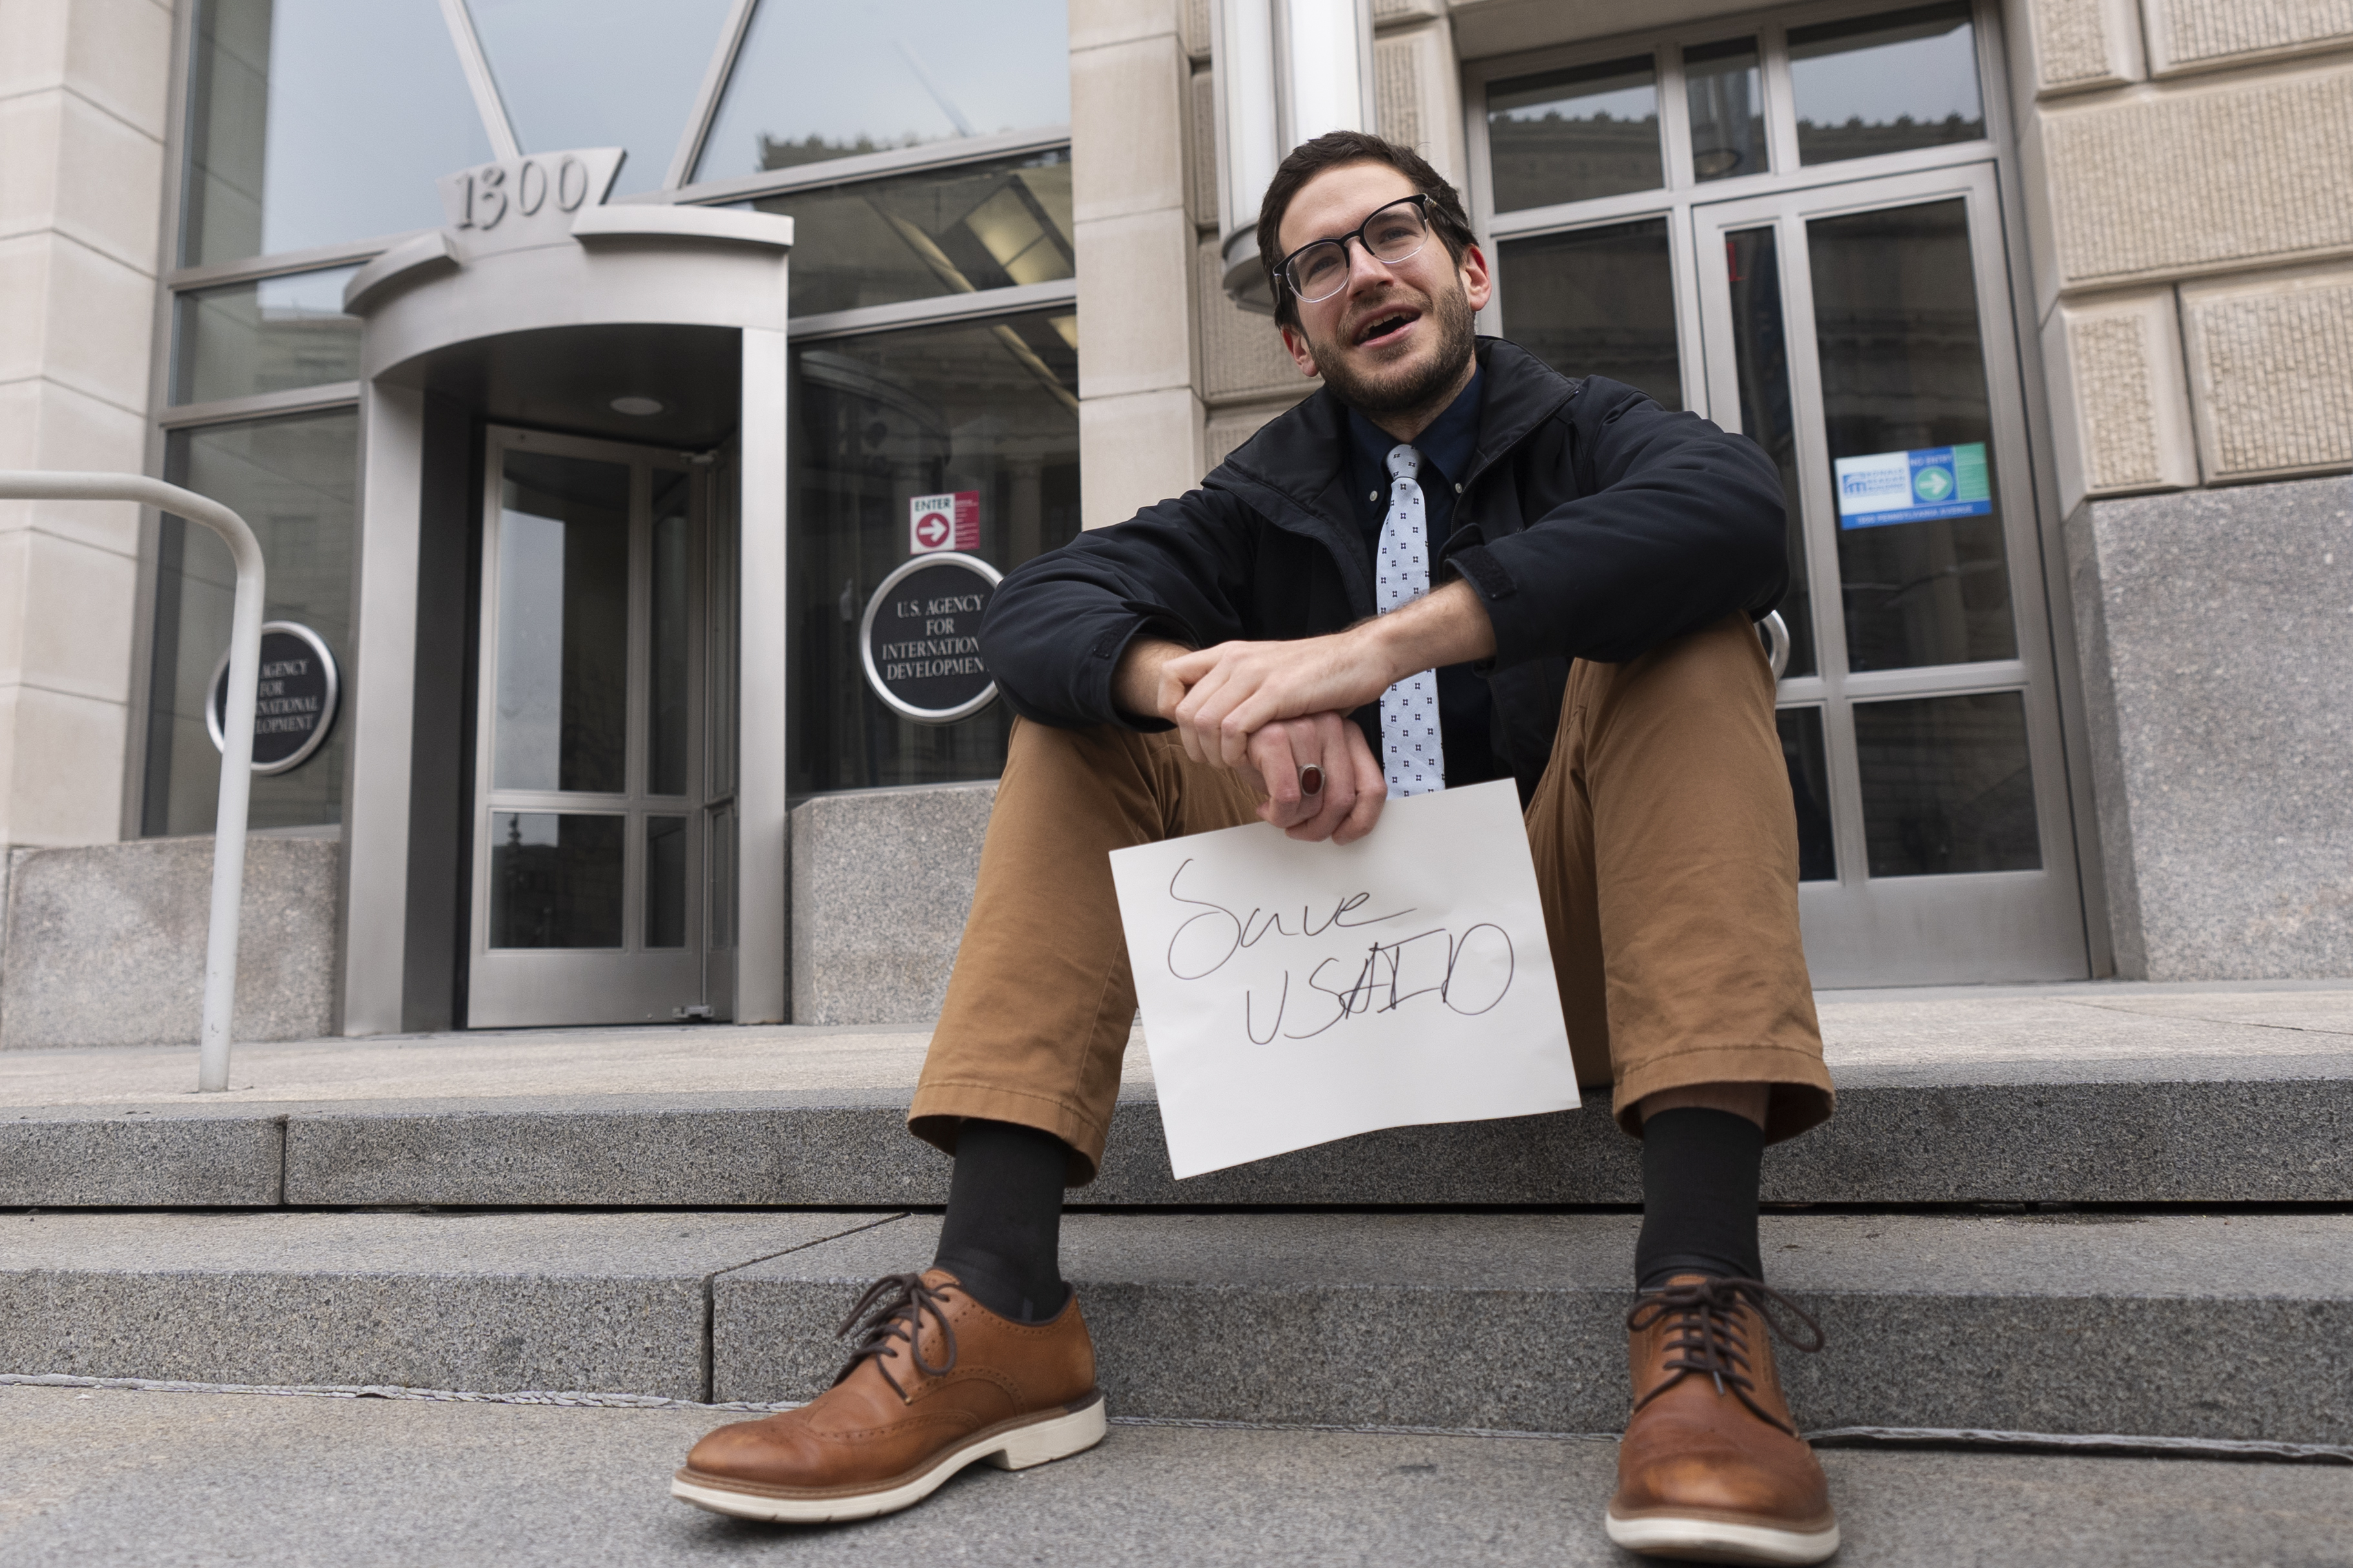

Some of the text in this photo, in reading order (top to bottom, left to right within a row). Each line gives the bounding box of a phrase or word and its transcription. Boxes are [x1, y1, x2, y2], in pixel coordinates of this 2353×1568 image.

[455, 156, 588, 230] 1300
[915, 498, 950, 512] ENTER
[897, 594, 985, 618] U.S. AGENCY
[926, 618, 955, 636] FOR
[882, 636, 980, 660] INTERNATION
[887, 657, 989, 680] DEVELOPMEN
[260, 680, 284, 698] FOR
[256, 695, 318, 716] NATIONAL
[256, 713, 313, 735] LOPMENT
[1167, 858, 1417, 979] Save
[1246, 922, 1514, 1045] USAID
